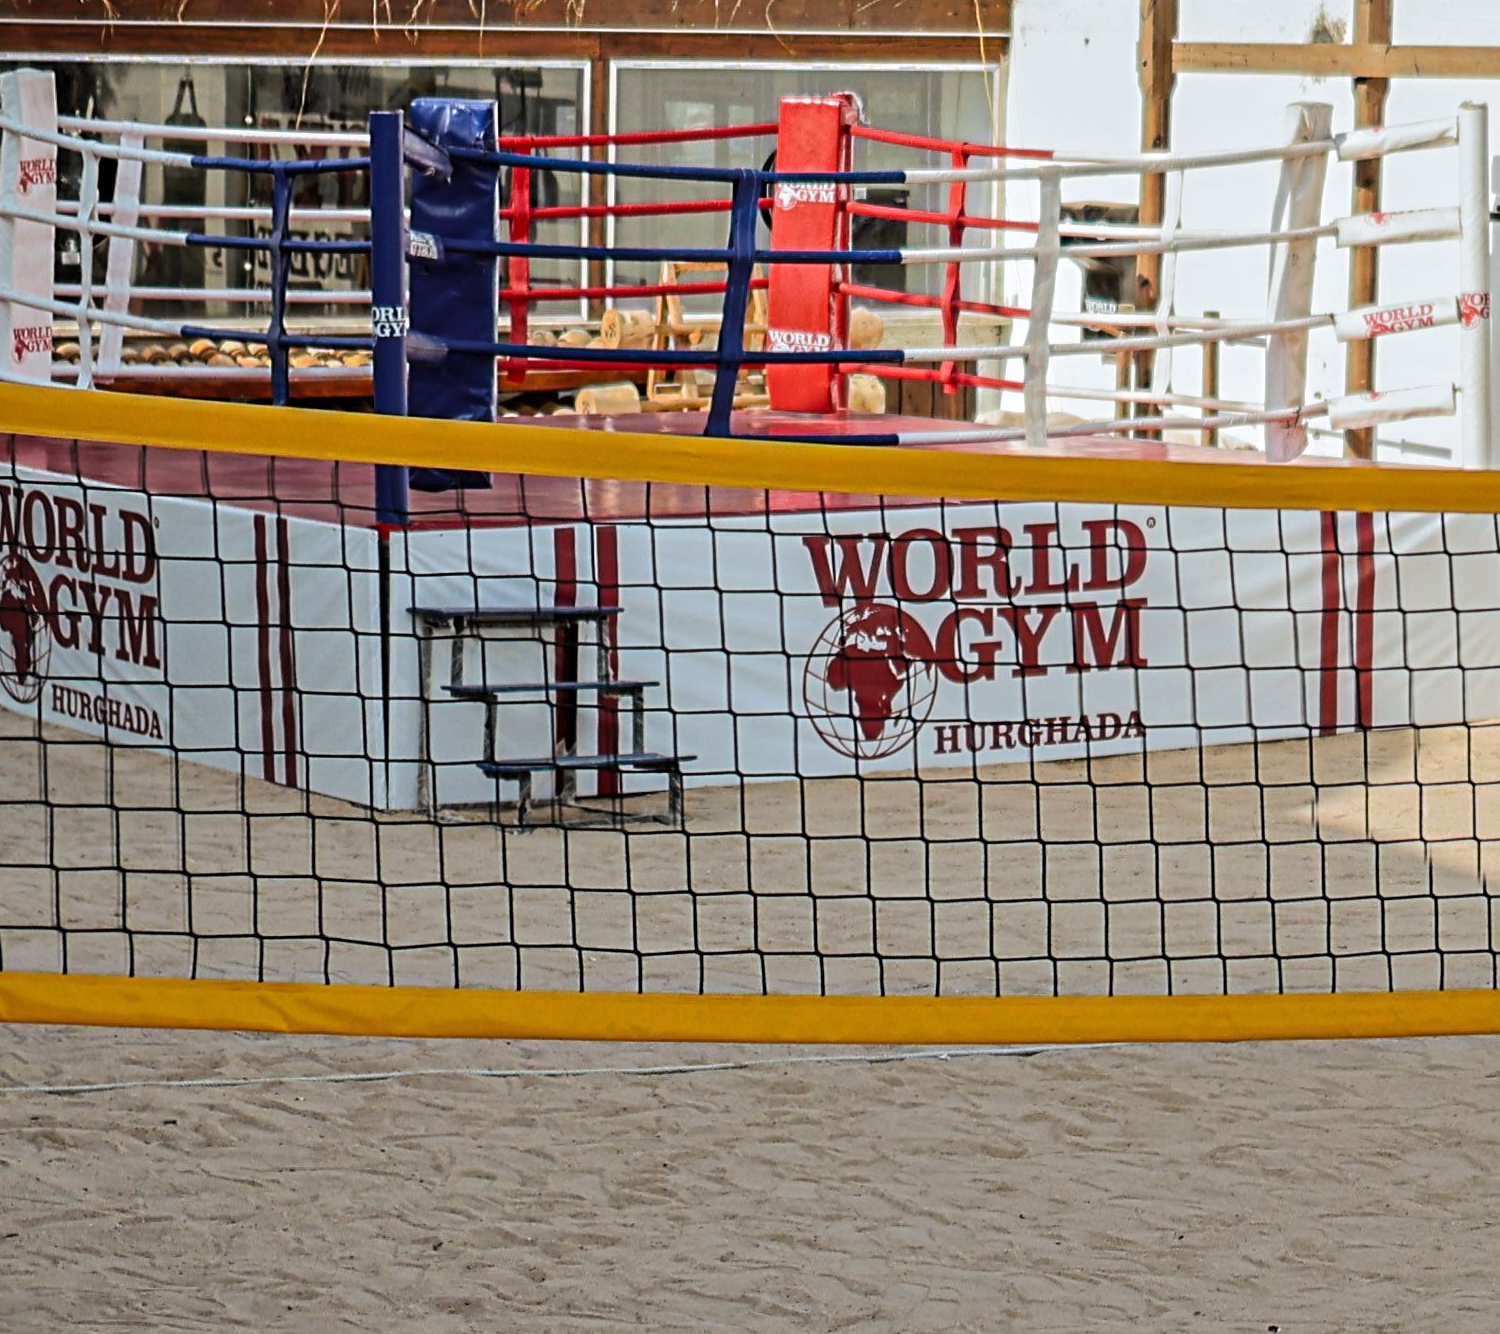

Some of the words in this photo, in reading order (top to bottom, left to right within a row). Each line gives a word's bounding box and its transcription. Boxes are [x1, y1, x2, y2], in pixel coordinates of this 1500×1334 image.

[796, 189, 836, 204] GYM
[768, 330, 831, 347] WORLD
[1363, 303, 1434, 326] WORLD
[802, 518, 1148, 608] WORLD
[48, 573, 161, 670] GYM
[935, 597, 1148, 684] GYM
[51, 683, 163, 740] HURGHADA
[933, 709, 1146, 755] HURGHADA
